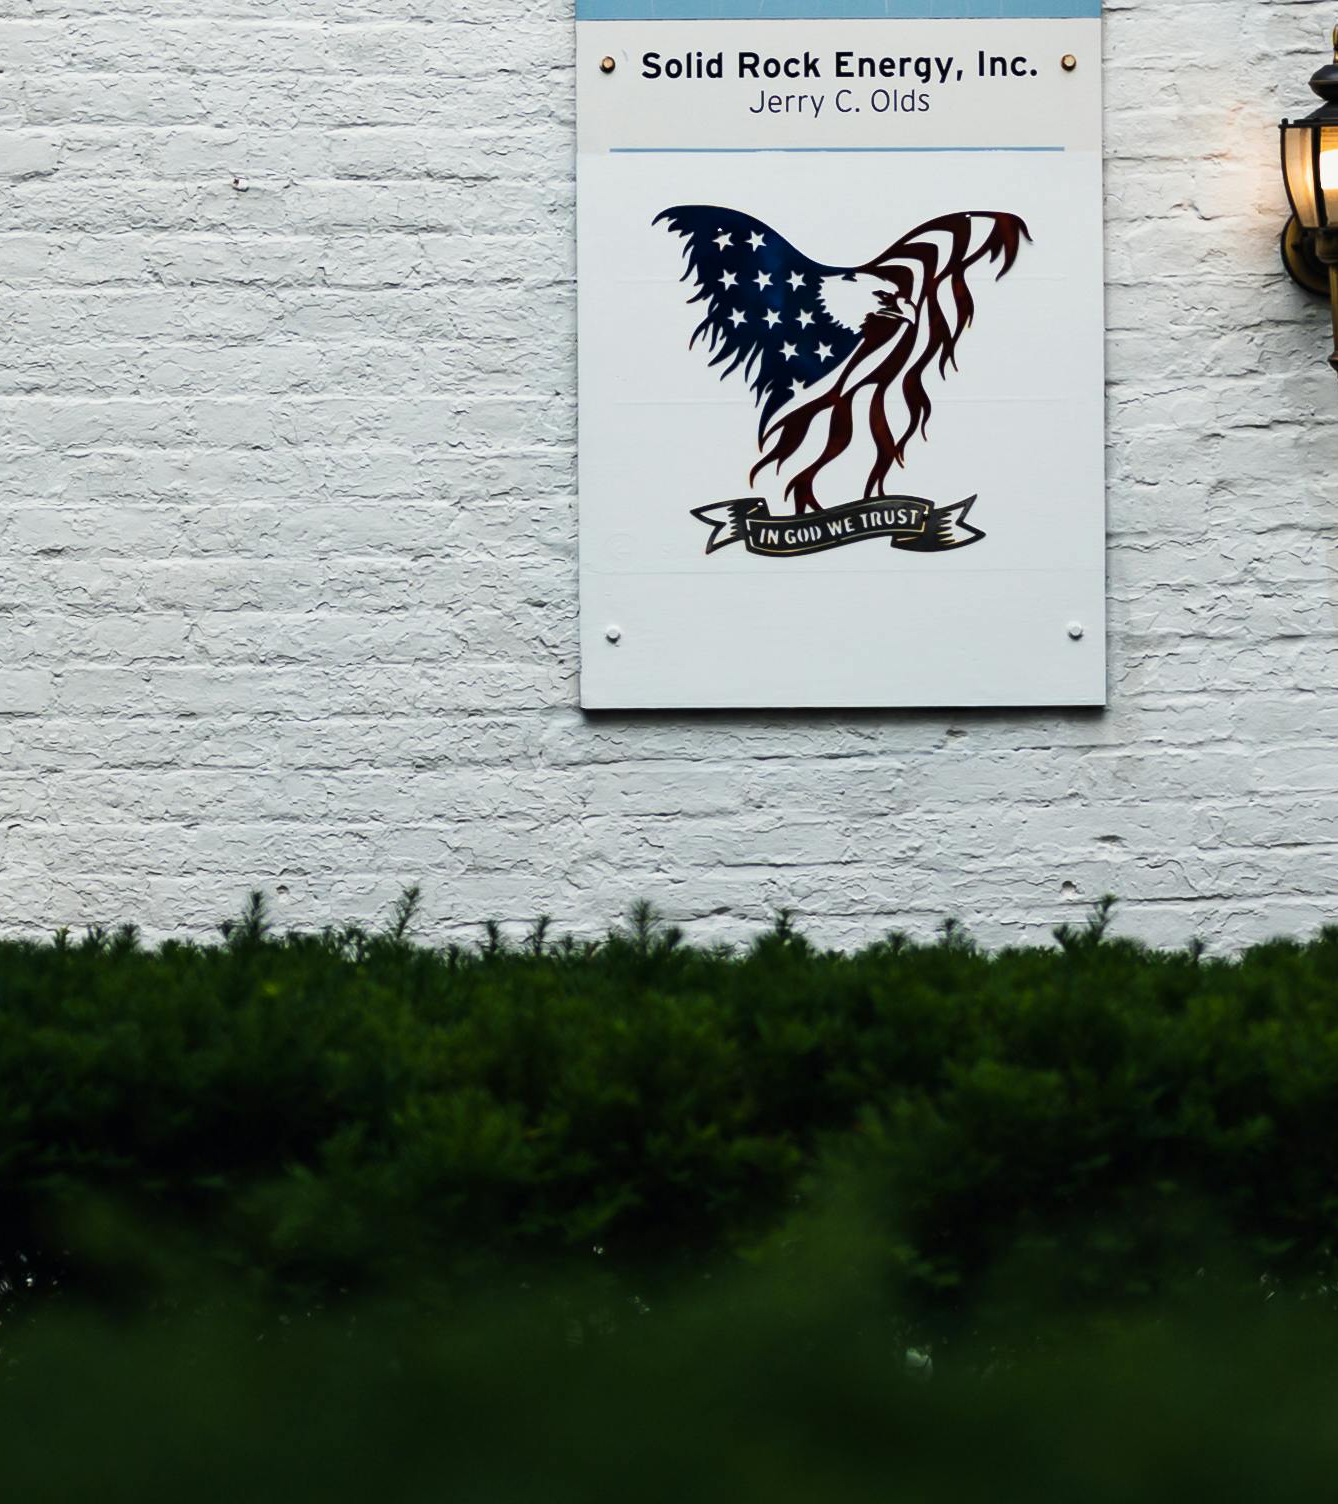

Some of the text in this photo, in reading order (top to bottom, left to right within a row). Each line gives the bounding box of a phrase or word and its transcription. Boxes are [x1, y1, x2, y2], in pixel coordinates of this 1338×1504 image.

[641, 50, 1038, 84] Solid Rock Energy, Inc.
[749, 87, 931, 119] Jerry C. Olds
[760, 509, 919, 545] IN GOD WE TRUST
